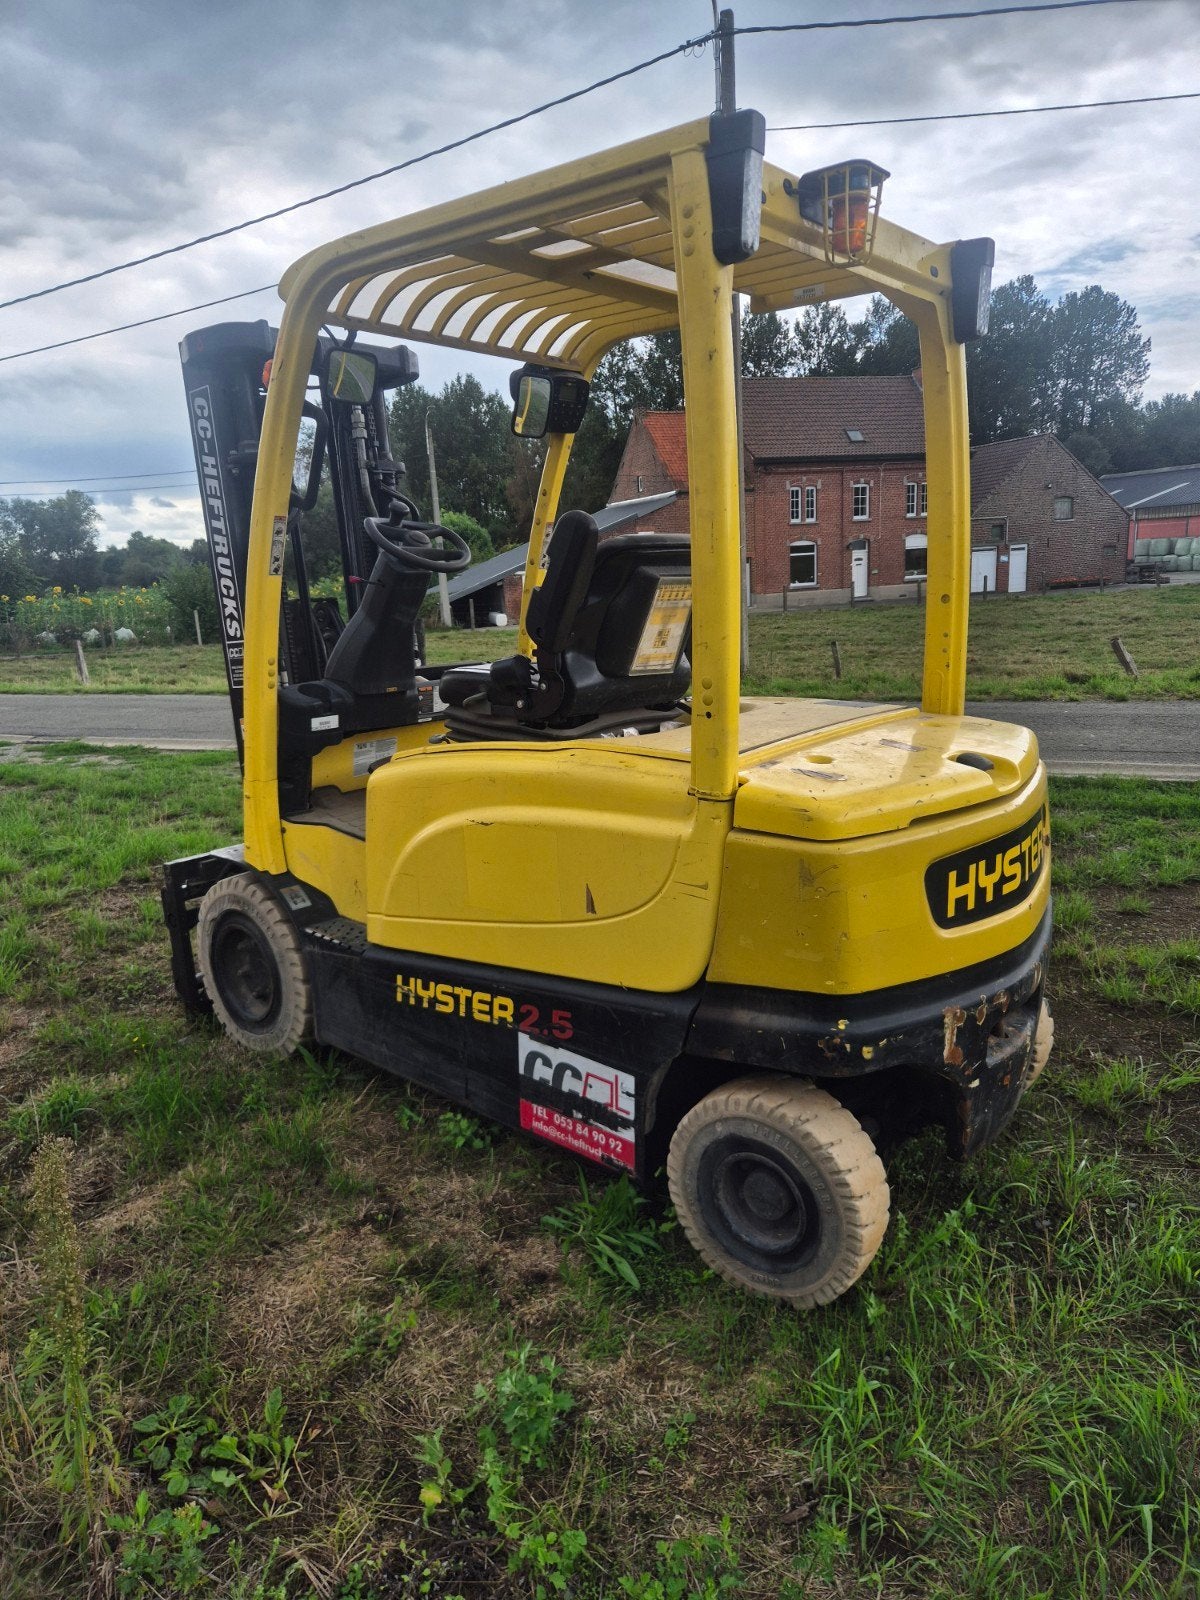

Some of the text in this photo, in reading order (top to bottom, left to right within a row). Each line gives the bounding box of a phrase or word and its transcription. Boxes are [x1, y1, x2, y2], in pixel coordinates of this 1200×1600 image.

[192, 396, 242, 639] CC-HEFTRUCKS
[946, 819, 1044, 919] HYSTER
[395, 973, 515, 1028] HYSTER
[518, 1004, 575, 1041] 2.5
[532, 1104, 623, 1153] TEL 053 84 90 92
